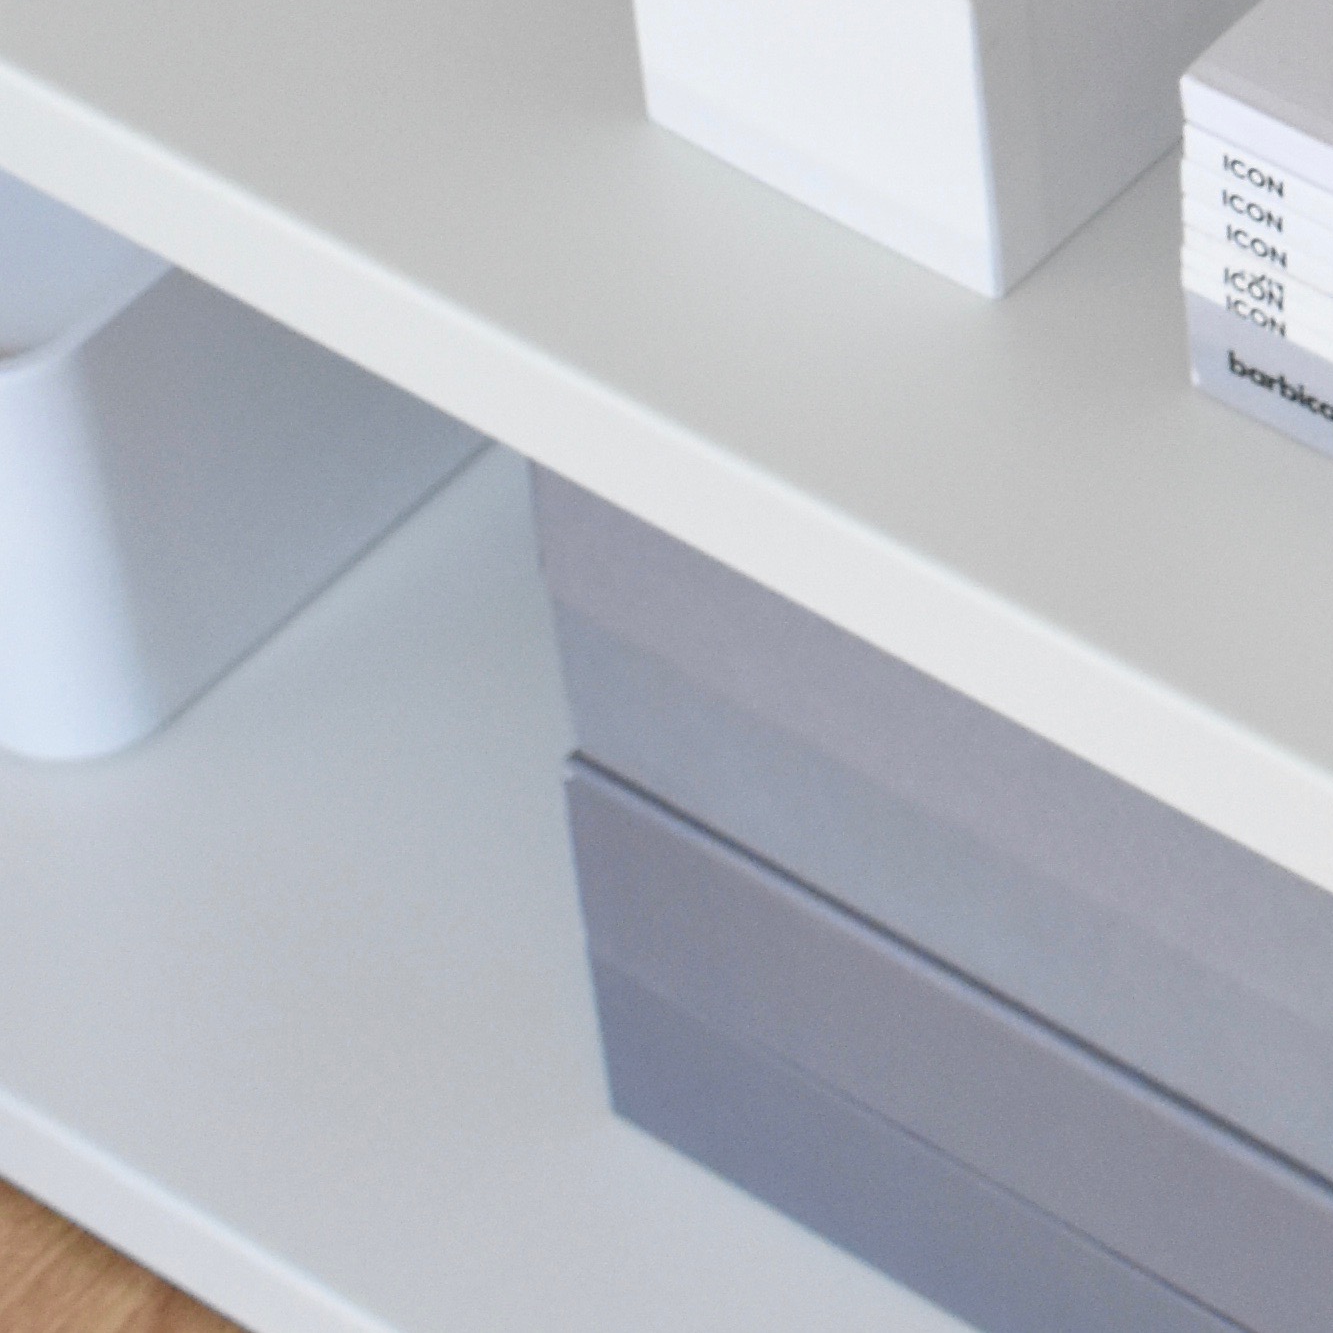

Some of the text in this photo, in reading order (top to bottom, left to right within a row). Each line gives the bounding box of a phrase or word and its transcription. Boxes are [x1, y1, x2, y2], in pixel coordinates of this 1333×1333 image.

[1223, 154, 1284, 198] ICON
[1222, 189, 1284, 233] ICON
[1226, 224, 1287, 268] ICON
[1224, 267, 1284, 312] ICON
[1226, 295, 1287, 337] ICON
